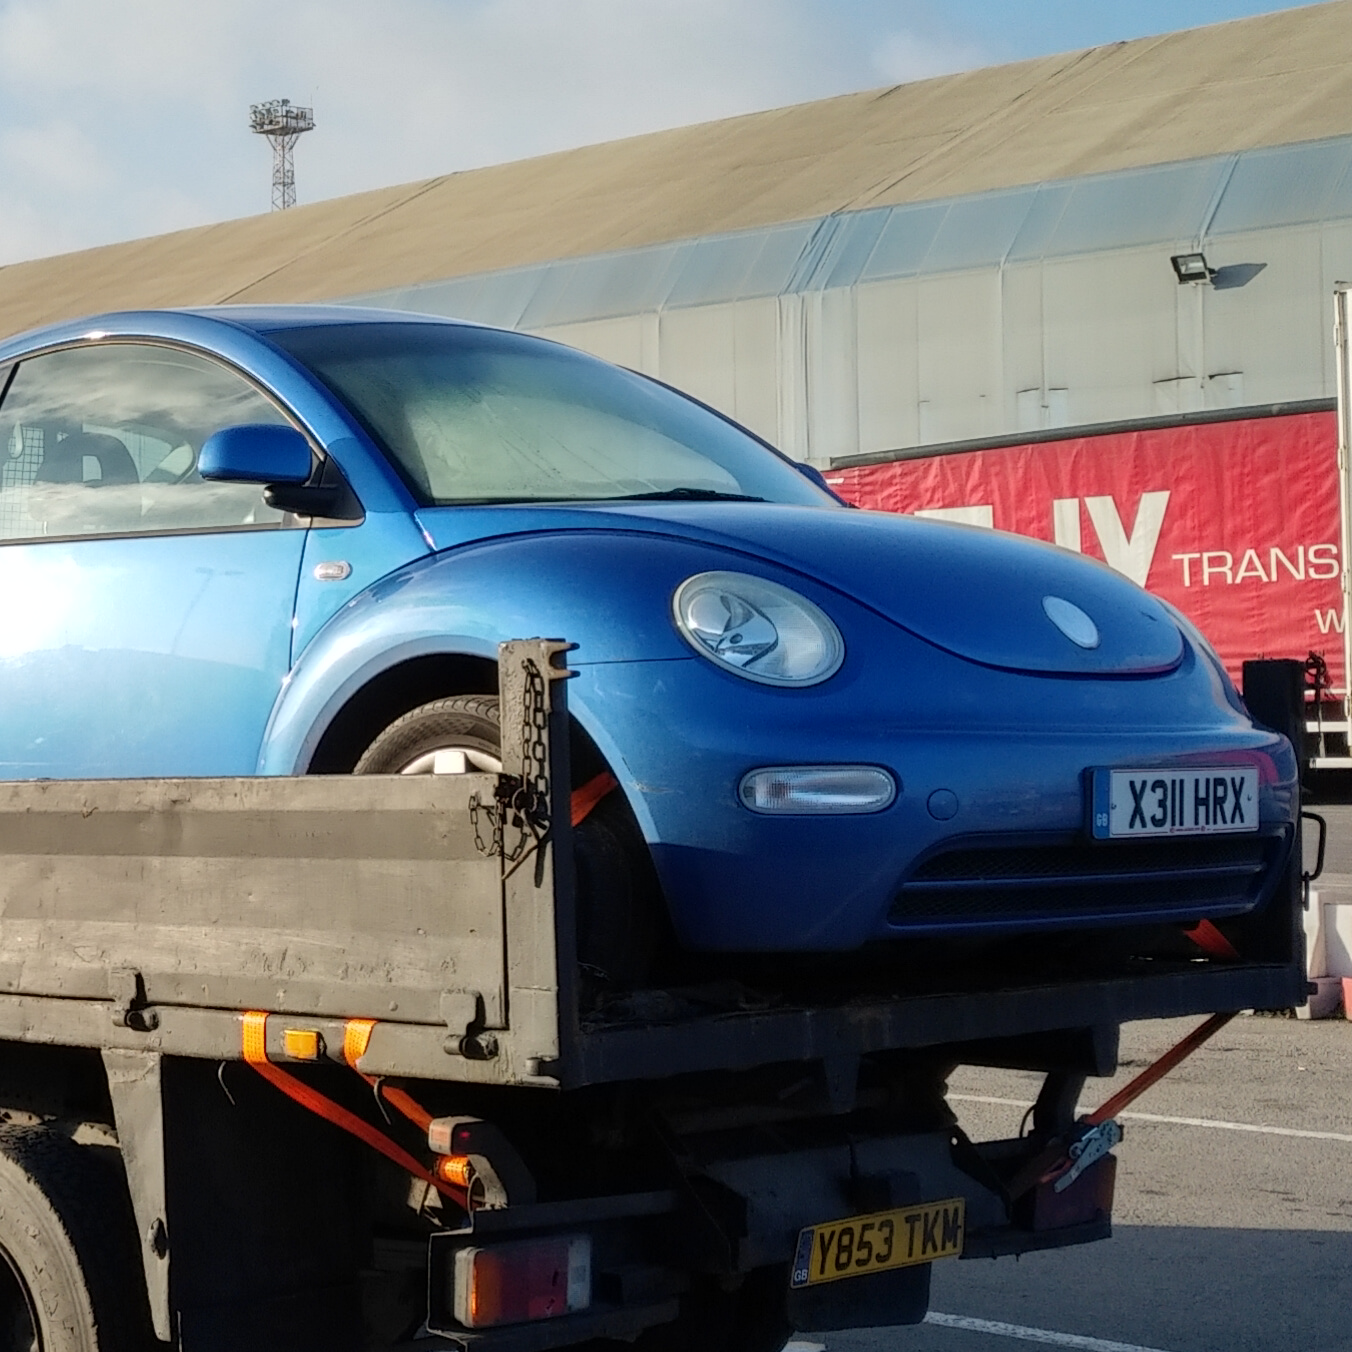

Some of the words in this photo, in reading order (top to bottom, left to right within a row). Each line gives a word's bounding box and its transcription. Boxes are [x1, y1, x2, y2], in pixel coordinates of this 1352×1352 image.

[1171, 543, 1340, 587] TRANS
[1096, 812, 1109, 828] GB
[1128, 778, 1185, 830] X311
[1193, 776, 1246, 826] HRX
[818, 1218, 895, 1276] Y853
[904, 1205, 961, 1258] TKM
[794, 1268, 808, 1283] GB
